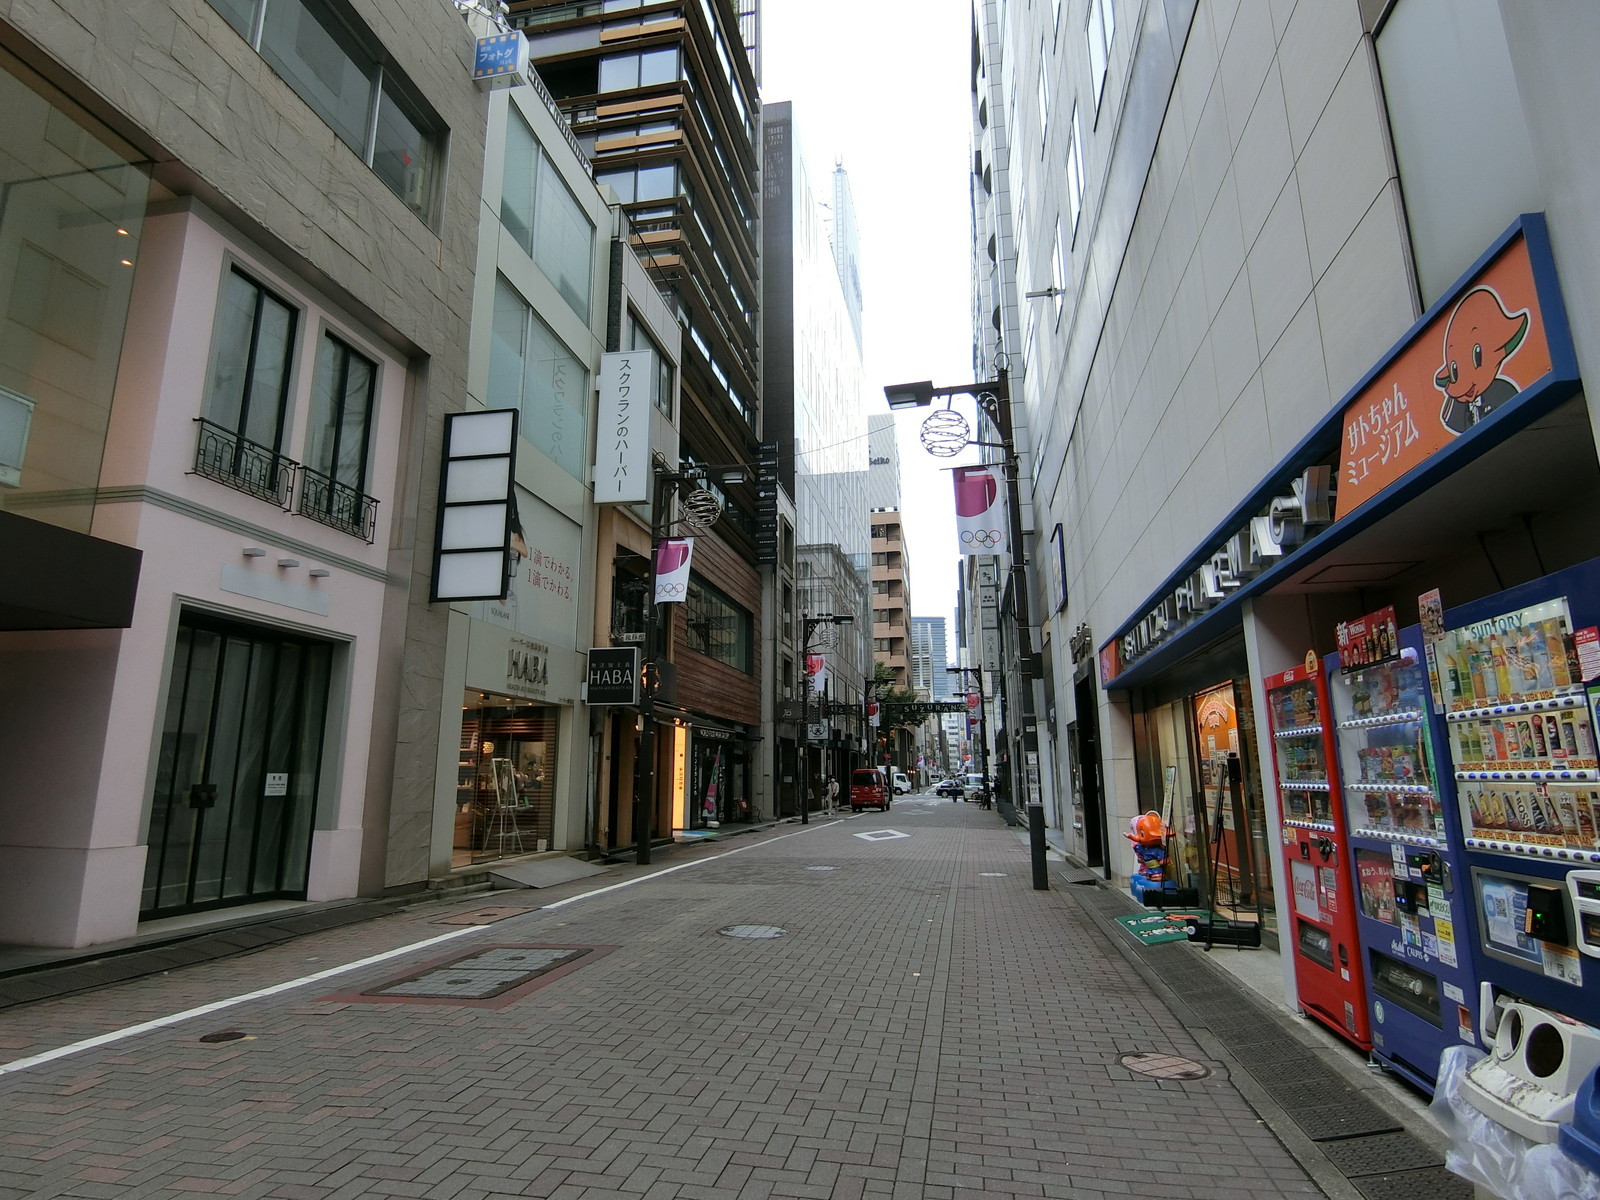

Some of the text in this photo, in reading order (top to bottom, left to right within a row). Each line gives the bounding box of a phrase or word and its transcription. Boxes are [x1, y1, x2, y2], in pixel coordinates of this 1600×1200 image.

[613, 359, 632, 493] スクワランのハーバー
[1346, 382, 1408, 456] サトちゃん
[1348, 412, 1419, 486] ミュージアム
[1174, 465, 1332, 622] PHARMACY
[507, 648, 549, 686] HABA
[1336, 621, 1349, 647] 新
[590, 669, 632, 685] HABA
